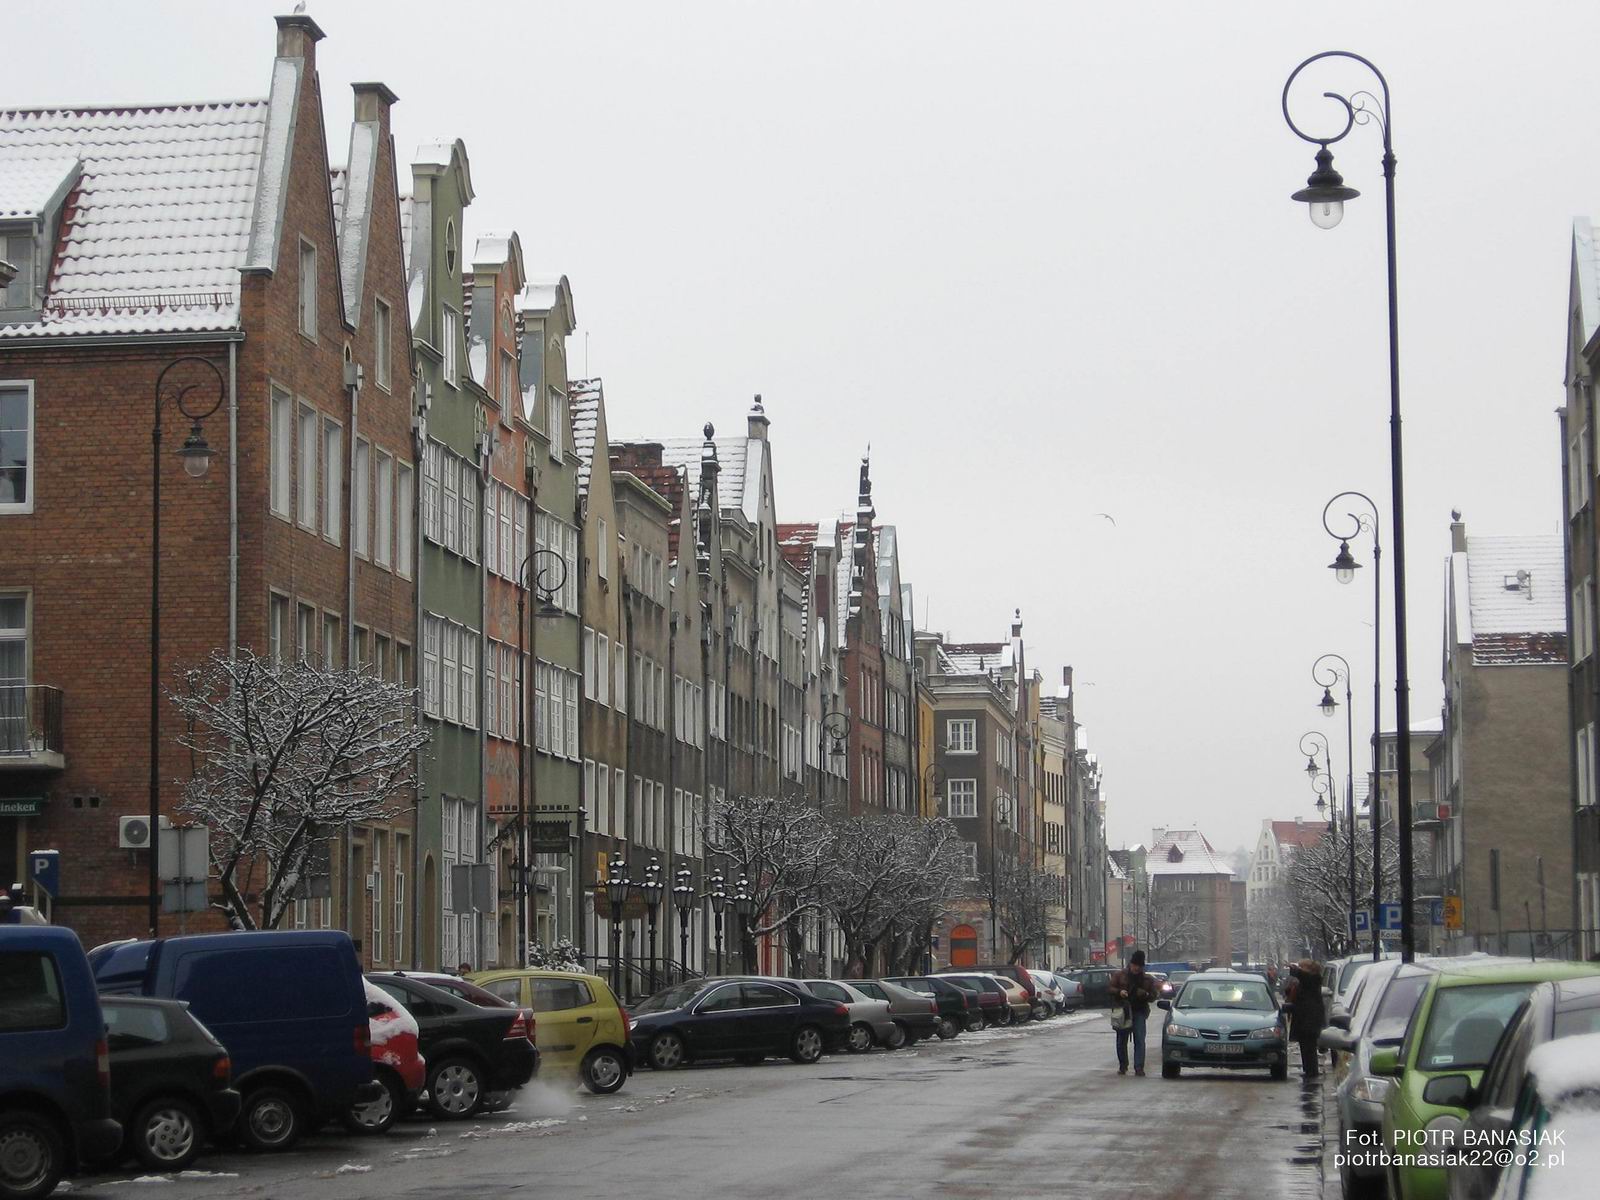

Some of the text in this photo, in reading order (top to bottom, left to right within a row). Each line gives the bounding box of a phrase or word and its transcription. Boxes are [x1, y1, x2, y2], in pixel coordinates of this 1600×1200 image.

[35, 858, 49, 874] P
[1355, 914, 1364, 929] P
[1386, 906, 1402, 928] P
